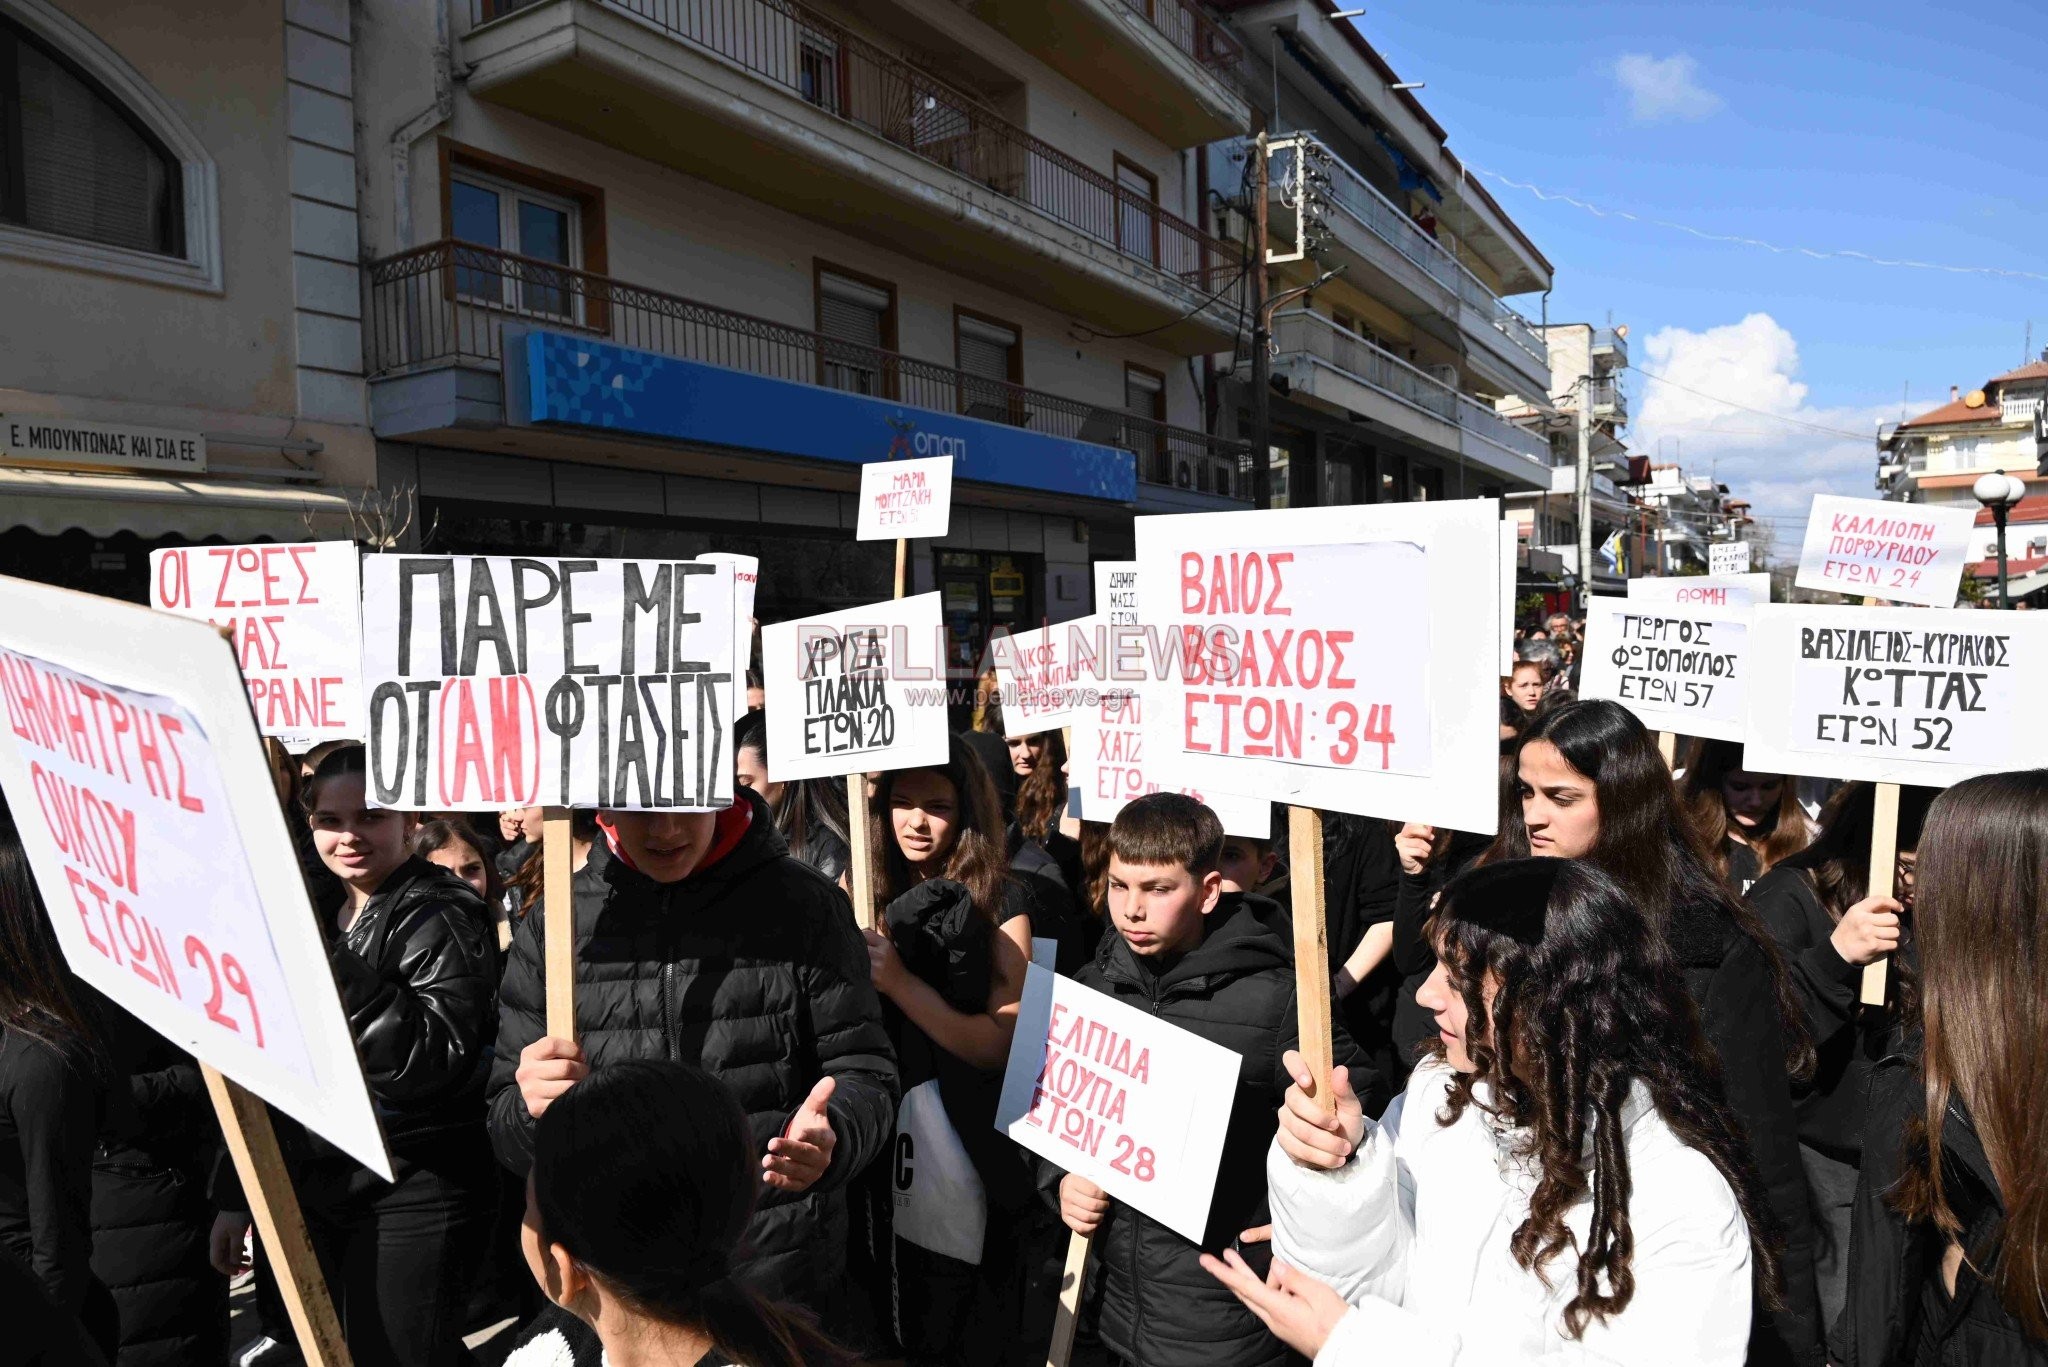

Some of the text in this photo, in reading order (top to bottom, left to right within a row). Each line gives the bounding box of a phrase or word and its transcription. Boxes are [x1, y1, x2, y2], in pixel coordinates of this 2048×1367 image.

[11, 425, 196, 461] Ε. ΜΠΟΥΝΤΩΝΑΣ ΚΑΙ ΣΙΑ ΕΕ
[874, 489, 932, 510] ΜΟΥΡΤΖΑΚΗ
[893, 471, 926, 490] ΜΑΡΙΑ
[1832, 513, 1936, 541] ΚΑΛΛΙΟΠΗ
[1824, 560, 1922, 588] ΕΤΩΝ 24
[1829, 536, 1939, 566] ΠΟΡΦΥΡΙΔΟΥ
[159, 546, 319, 608] ΟΙ ΖΩΕΣ
[1109, 572, 1137, 589] ΔΗΜΗ
[1181, 551, 1294, 616] ΒΑΙΟΣ
[398, 558, 716, 676] ΠΑΡΕ ΜΕ
[1623, 615, 1713, 646] ΓΙΩΡΓΟΣ
[803, 628, 883, 679] ΧΡΥΣΑ
[1181, 624, 1356, 690] ΒΛΑΧΟΣ
[1611, 645, 1737, 679] ΦΩΤΟΠΟΥΛΟΣ
[1801, 627, 2010, 667] ΒΑΣΙΛΕΙΟΣ-ΚΥΡΙΑΚΟΣ
[245, 677, 346, 727] ΡΑΝΕ
[805, 669, 887, 716] ΠΛΑΚΙΑ
[1619, 674, 1714, 708] ΕΤΩΝ 57
[1842, 666, 1988, 712] ΚΩΤΤΑΣ
[0, 653, 206, 814] ΔΗΜΗΤΡΗΣ
[1816, 714, 1953, 751] ΕΤΩΝ 52
[63, 864, 266, 1049] ΕΤΩΝ 29
[1047, 1002, 1150, 1085] ΕΛΠΙΔΑ
[1036, 1044, 1127, 1125] ΧΟΥΠΑ
[1026, 1089, 1156, 1182] ΕΤΩΝ 28
